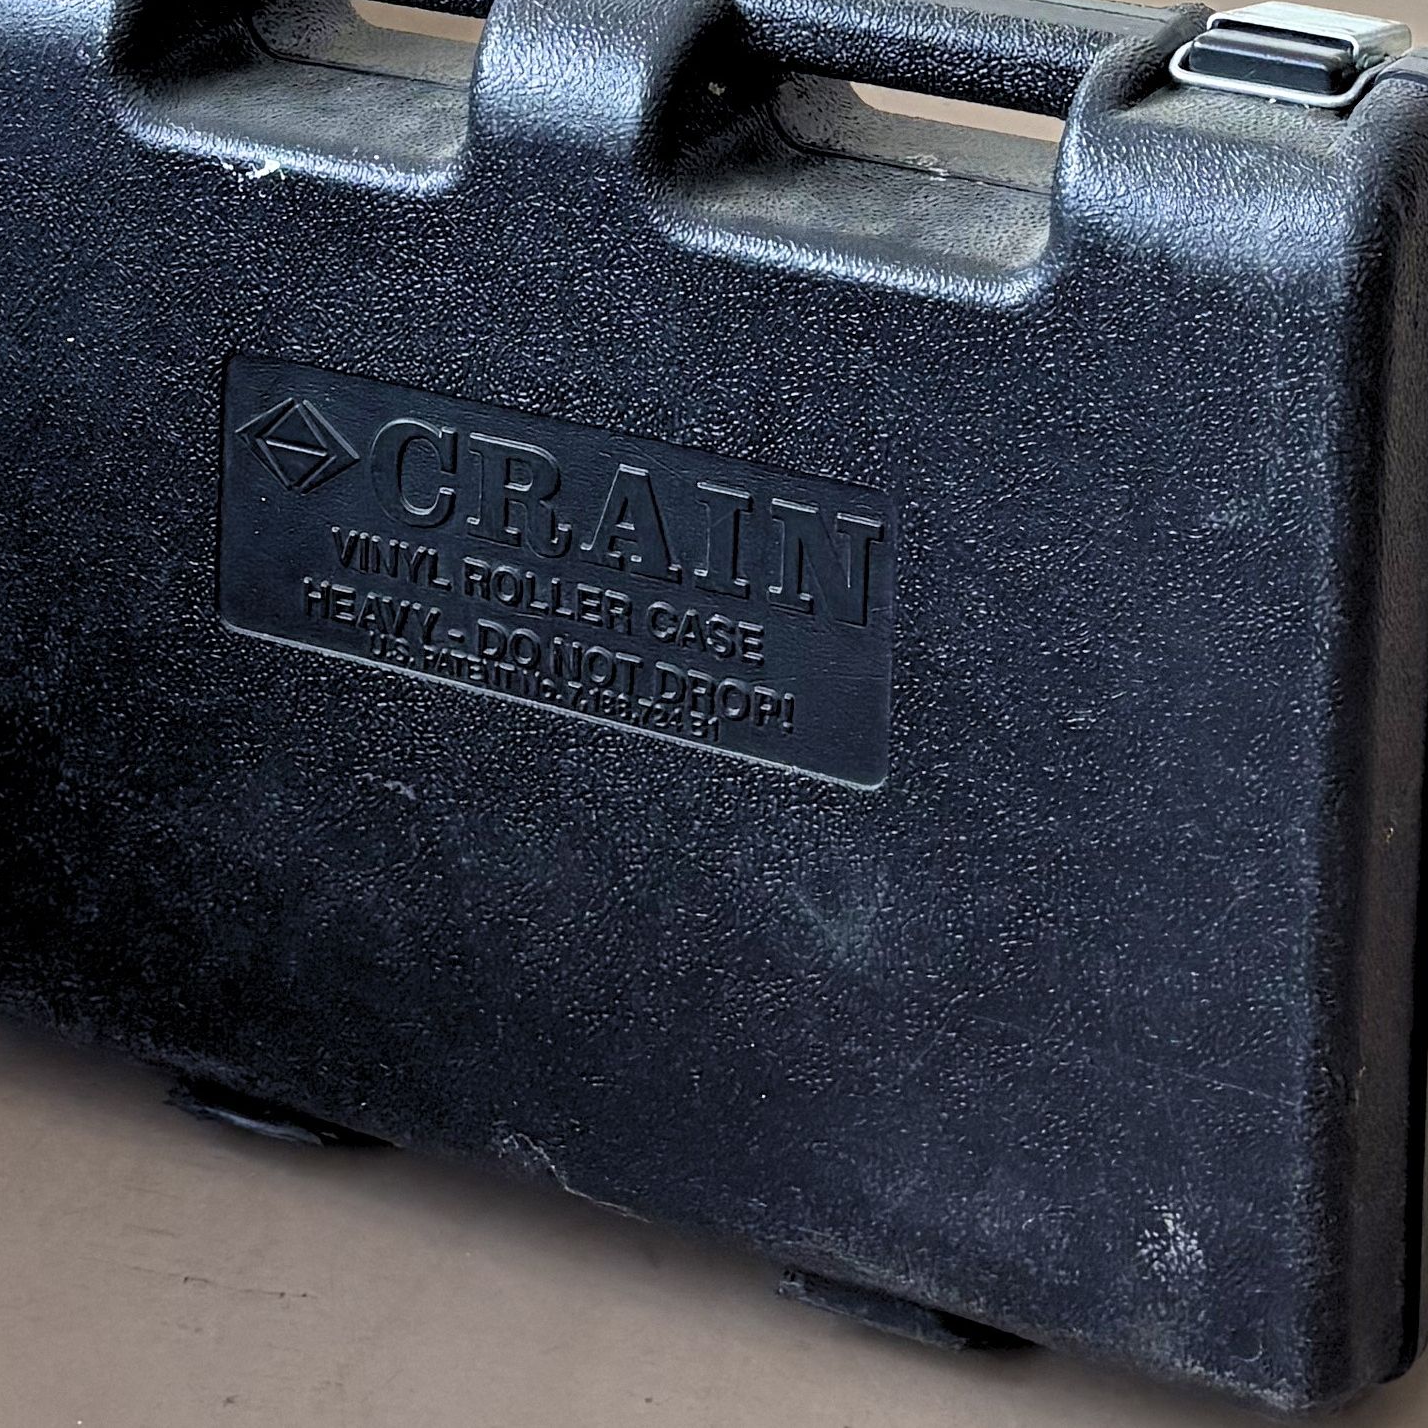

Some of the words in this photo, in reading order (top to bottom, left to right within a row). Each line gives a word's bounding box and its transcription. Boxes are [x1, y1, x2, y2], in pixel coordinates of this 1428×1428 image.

[331, 526, 453, 590] VINYL
[462, 557, 634, 637] ROLLER
[646, 601, 766, 666] CASE
[370, 417, 884, 628] CRAIN
[303, 576, 442, 642] HEAVY
[476, 617, 541, 671] DO
[553, 635, 644, 697] NOT
[654, 660, 797, 735] DROP!
